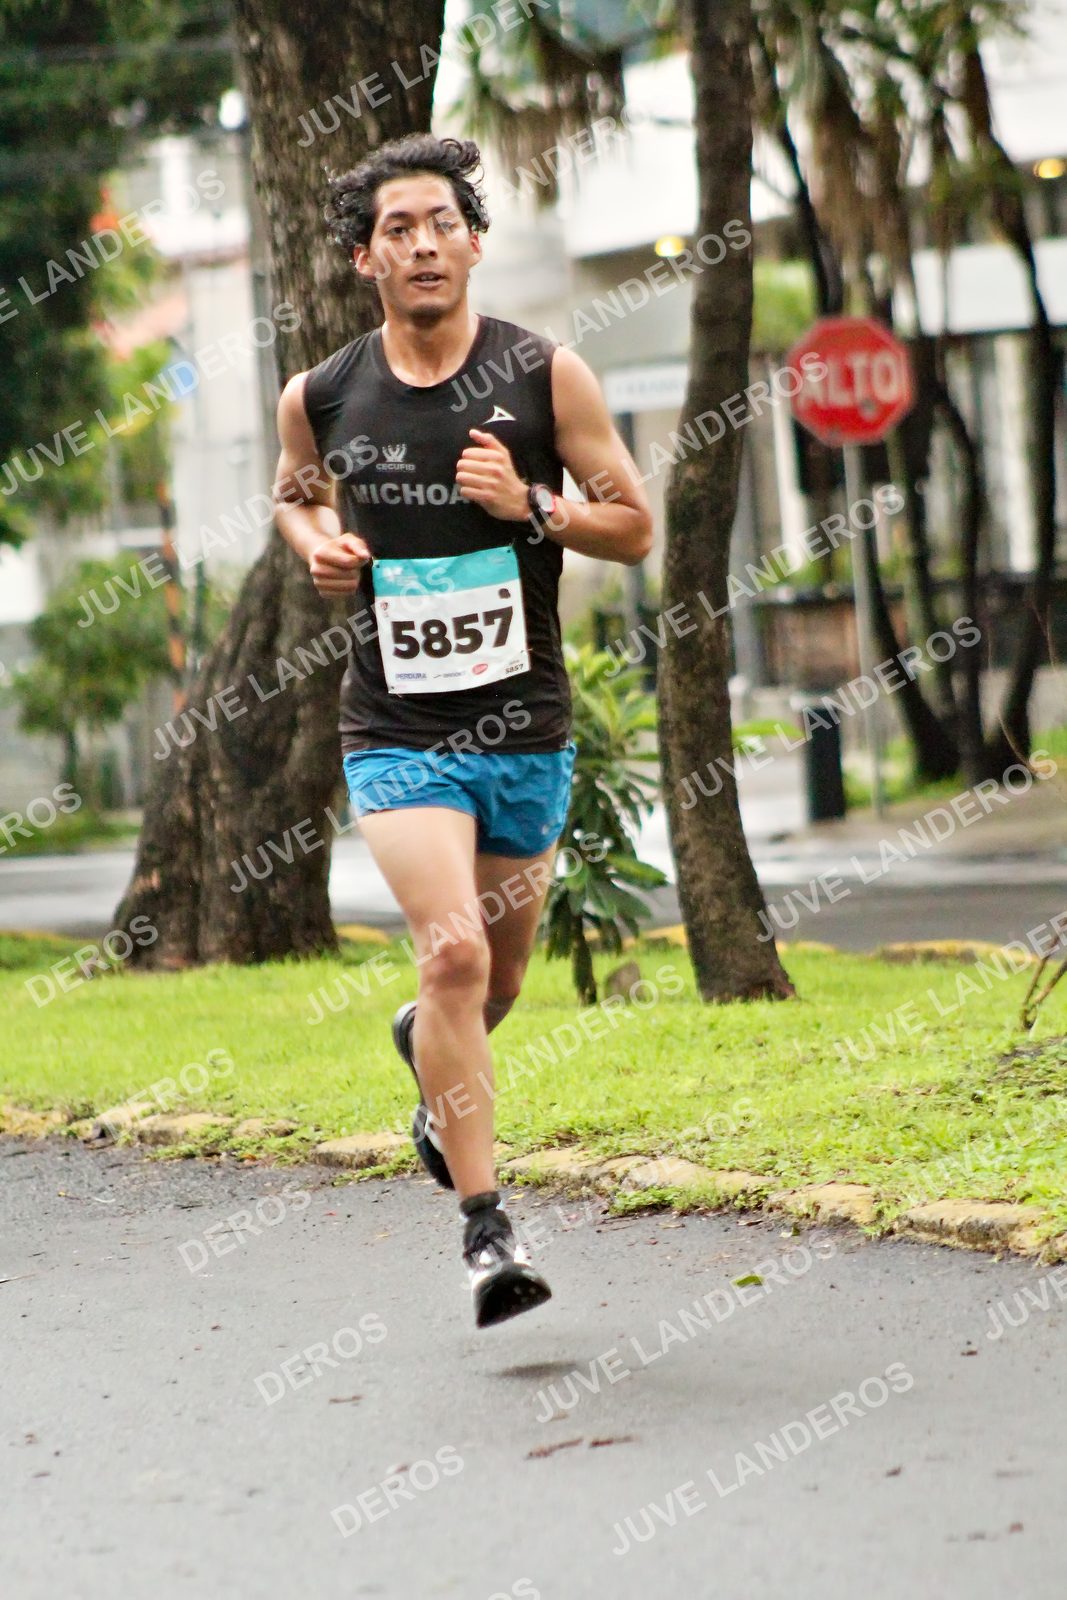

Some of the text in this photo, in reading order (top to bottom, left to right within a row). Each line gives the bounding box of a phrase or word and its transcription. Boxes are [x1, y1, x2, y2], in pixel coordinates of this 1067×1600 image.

[797, 352, 899, 408] ALTO
[351, 482, 470, 505] MICHOA
[391, 606, 513, 660] 5857
